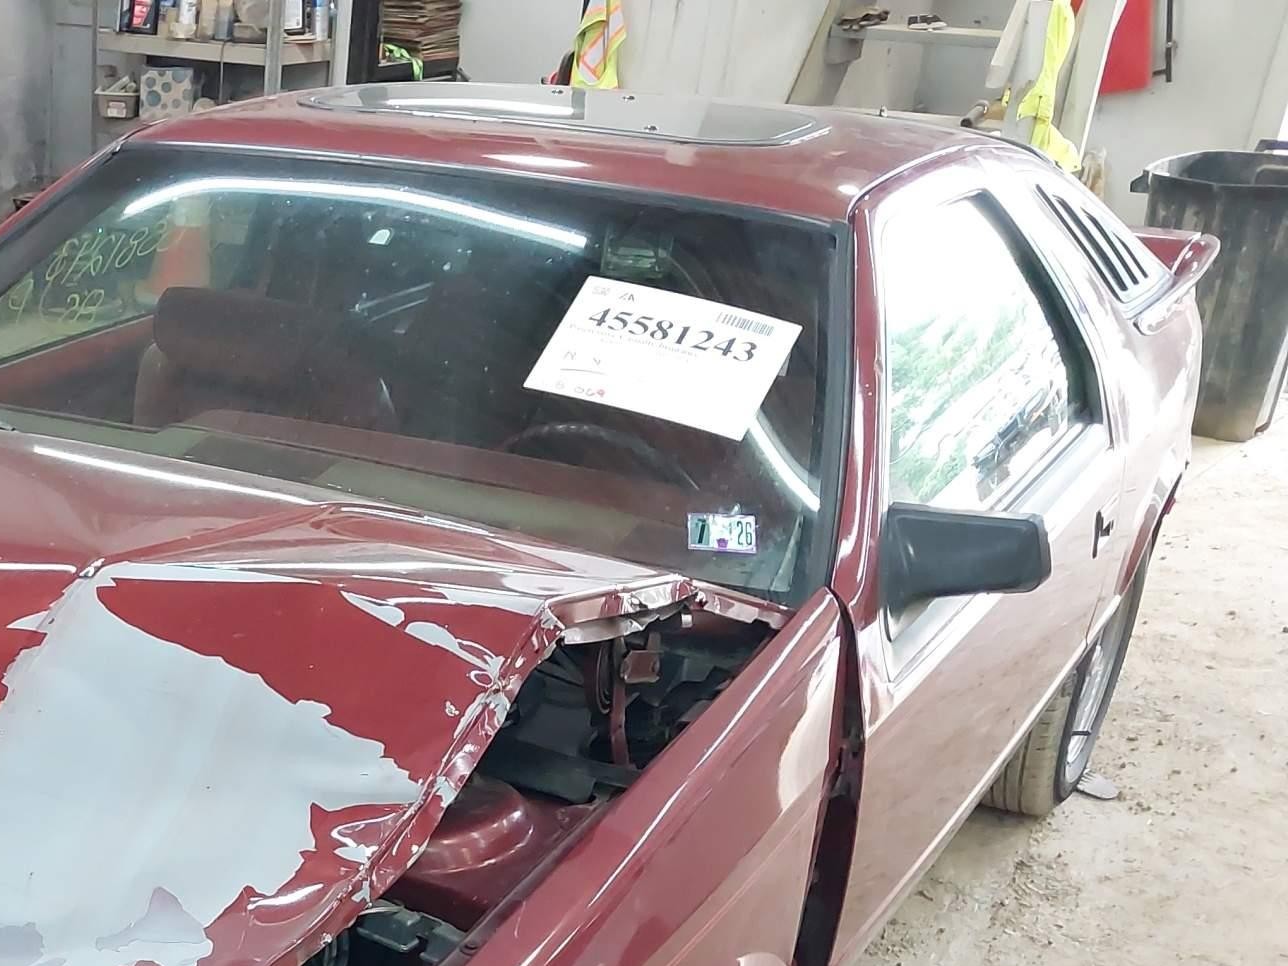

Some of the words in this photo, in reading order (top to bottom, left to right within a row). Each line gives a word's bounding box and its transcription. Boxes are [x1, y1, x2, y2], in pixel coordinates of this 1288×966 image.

[588, 307, 758, 362] 45581243
[697, 518, 707, 544] 7
[736, 520, 753, 546] 26
